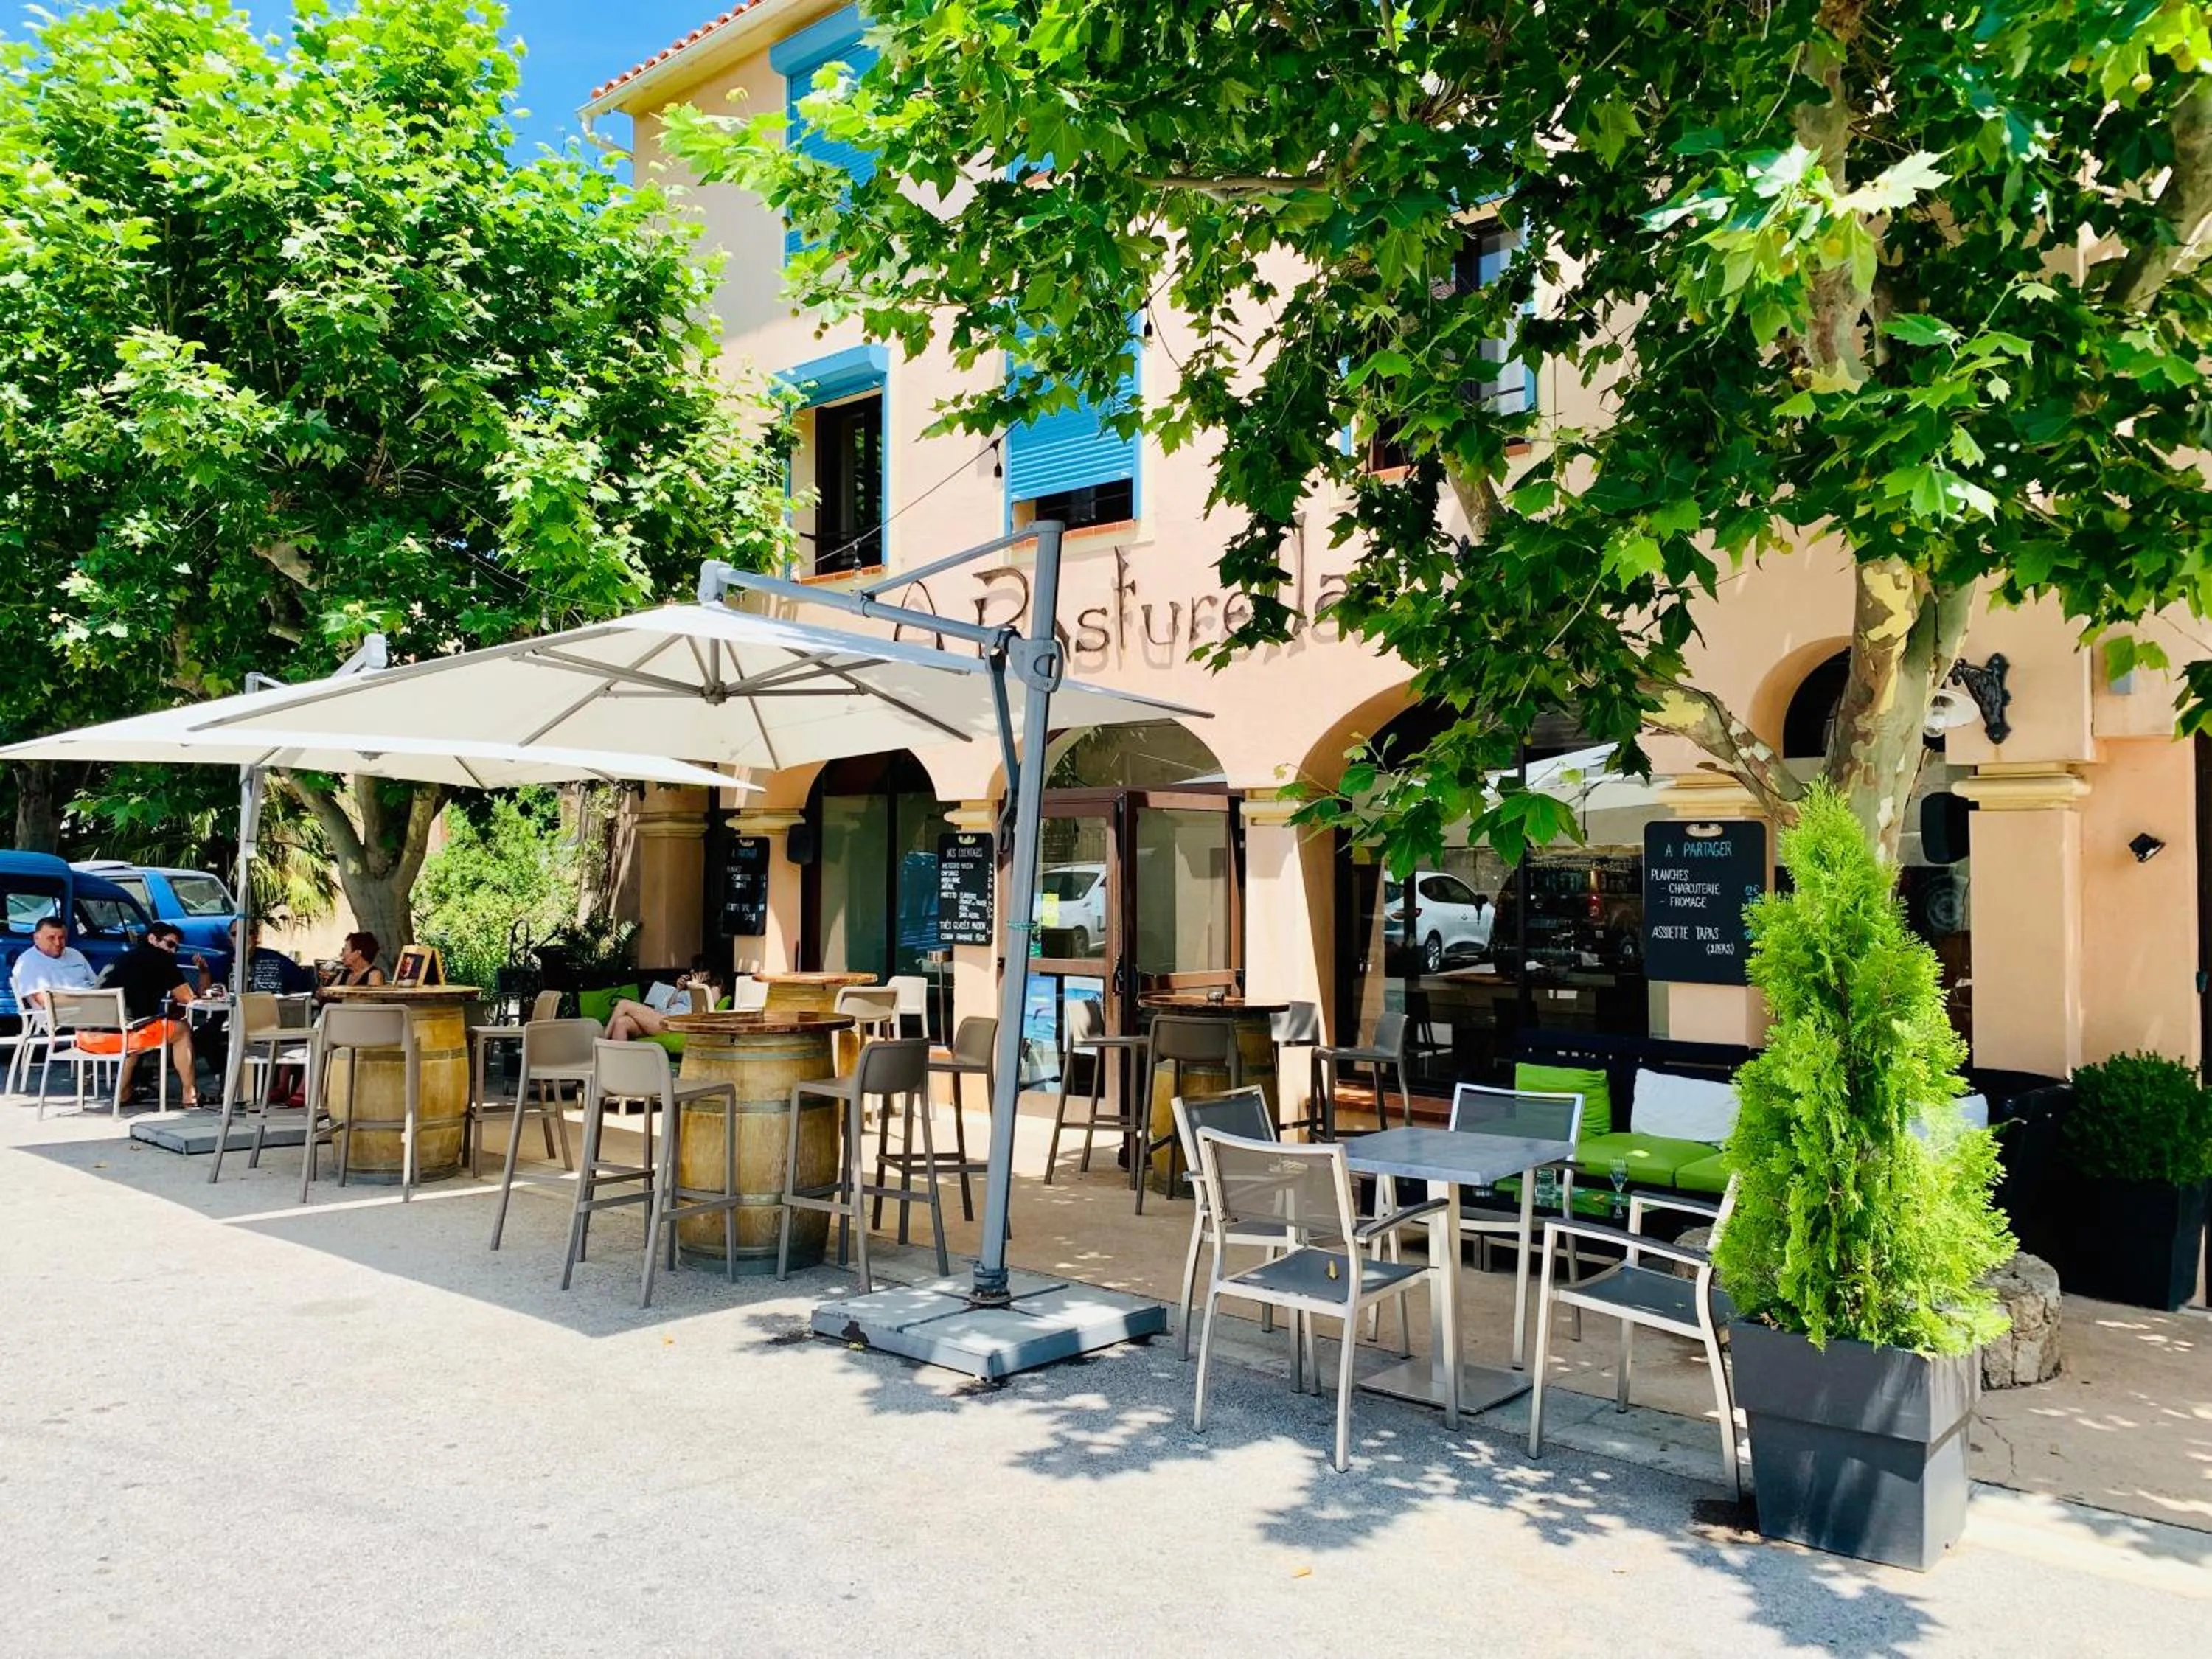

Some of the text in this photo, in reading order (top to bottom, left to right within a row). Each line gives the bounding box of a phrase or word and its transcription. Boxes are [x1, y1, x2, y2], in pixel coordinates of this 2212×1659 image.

[973, 510, 1354, 664] Psturela
[1664, 841, 1732, 857] A PARTAGER
[1651, 869, 1689, 881] PLANCHES
[1670, 896, 1706, 908] FROMAGE
[1652, 926, 1719, 940] ASSIETTE TAPAS
